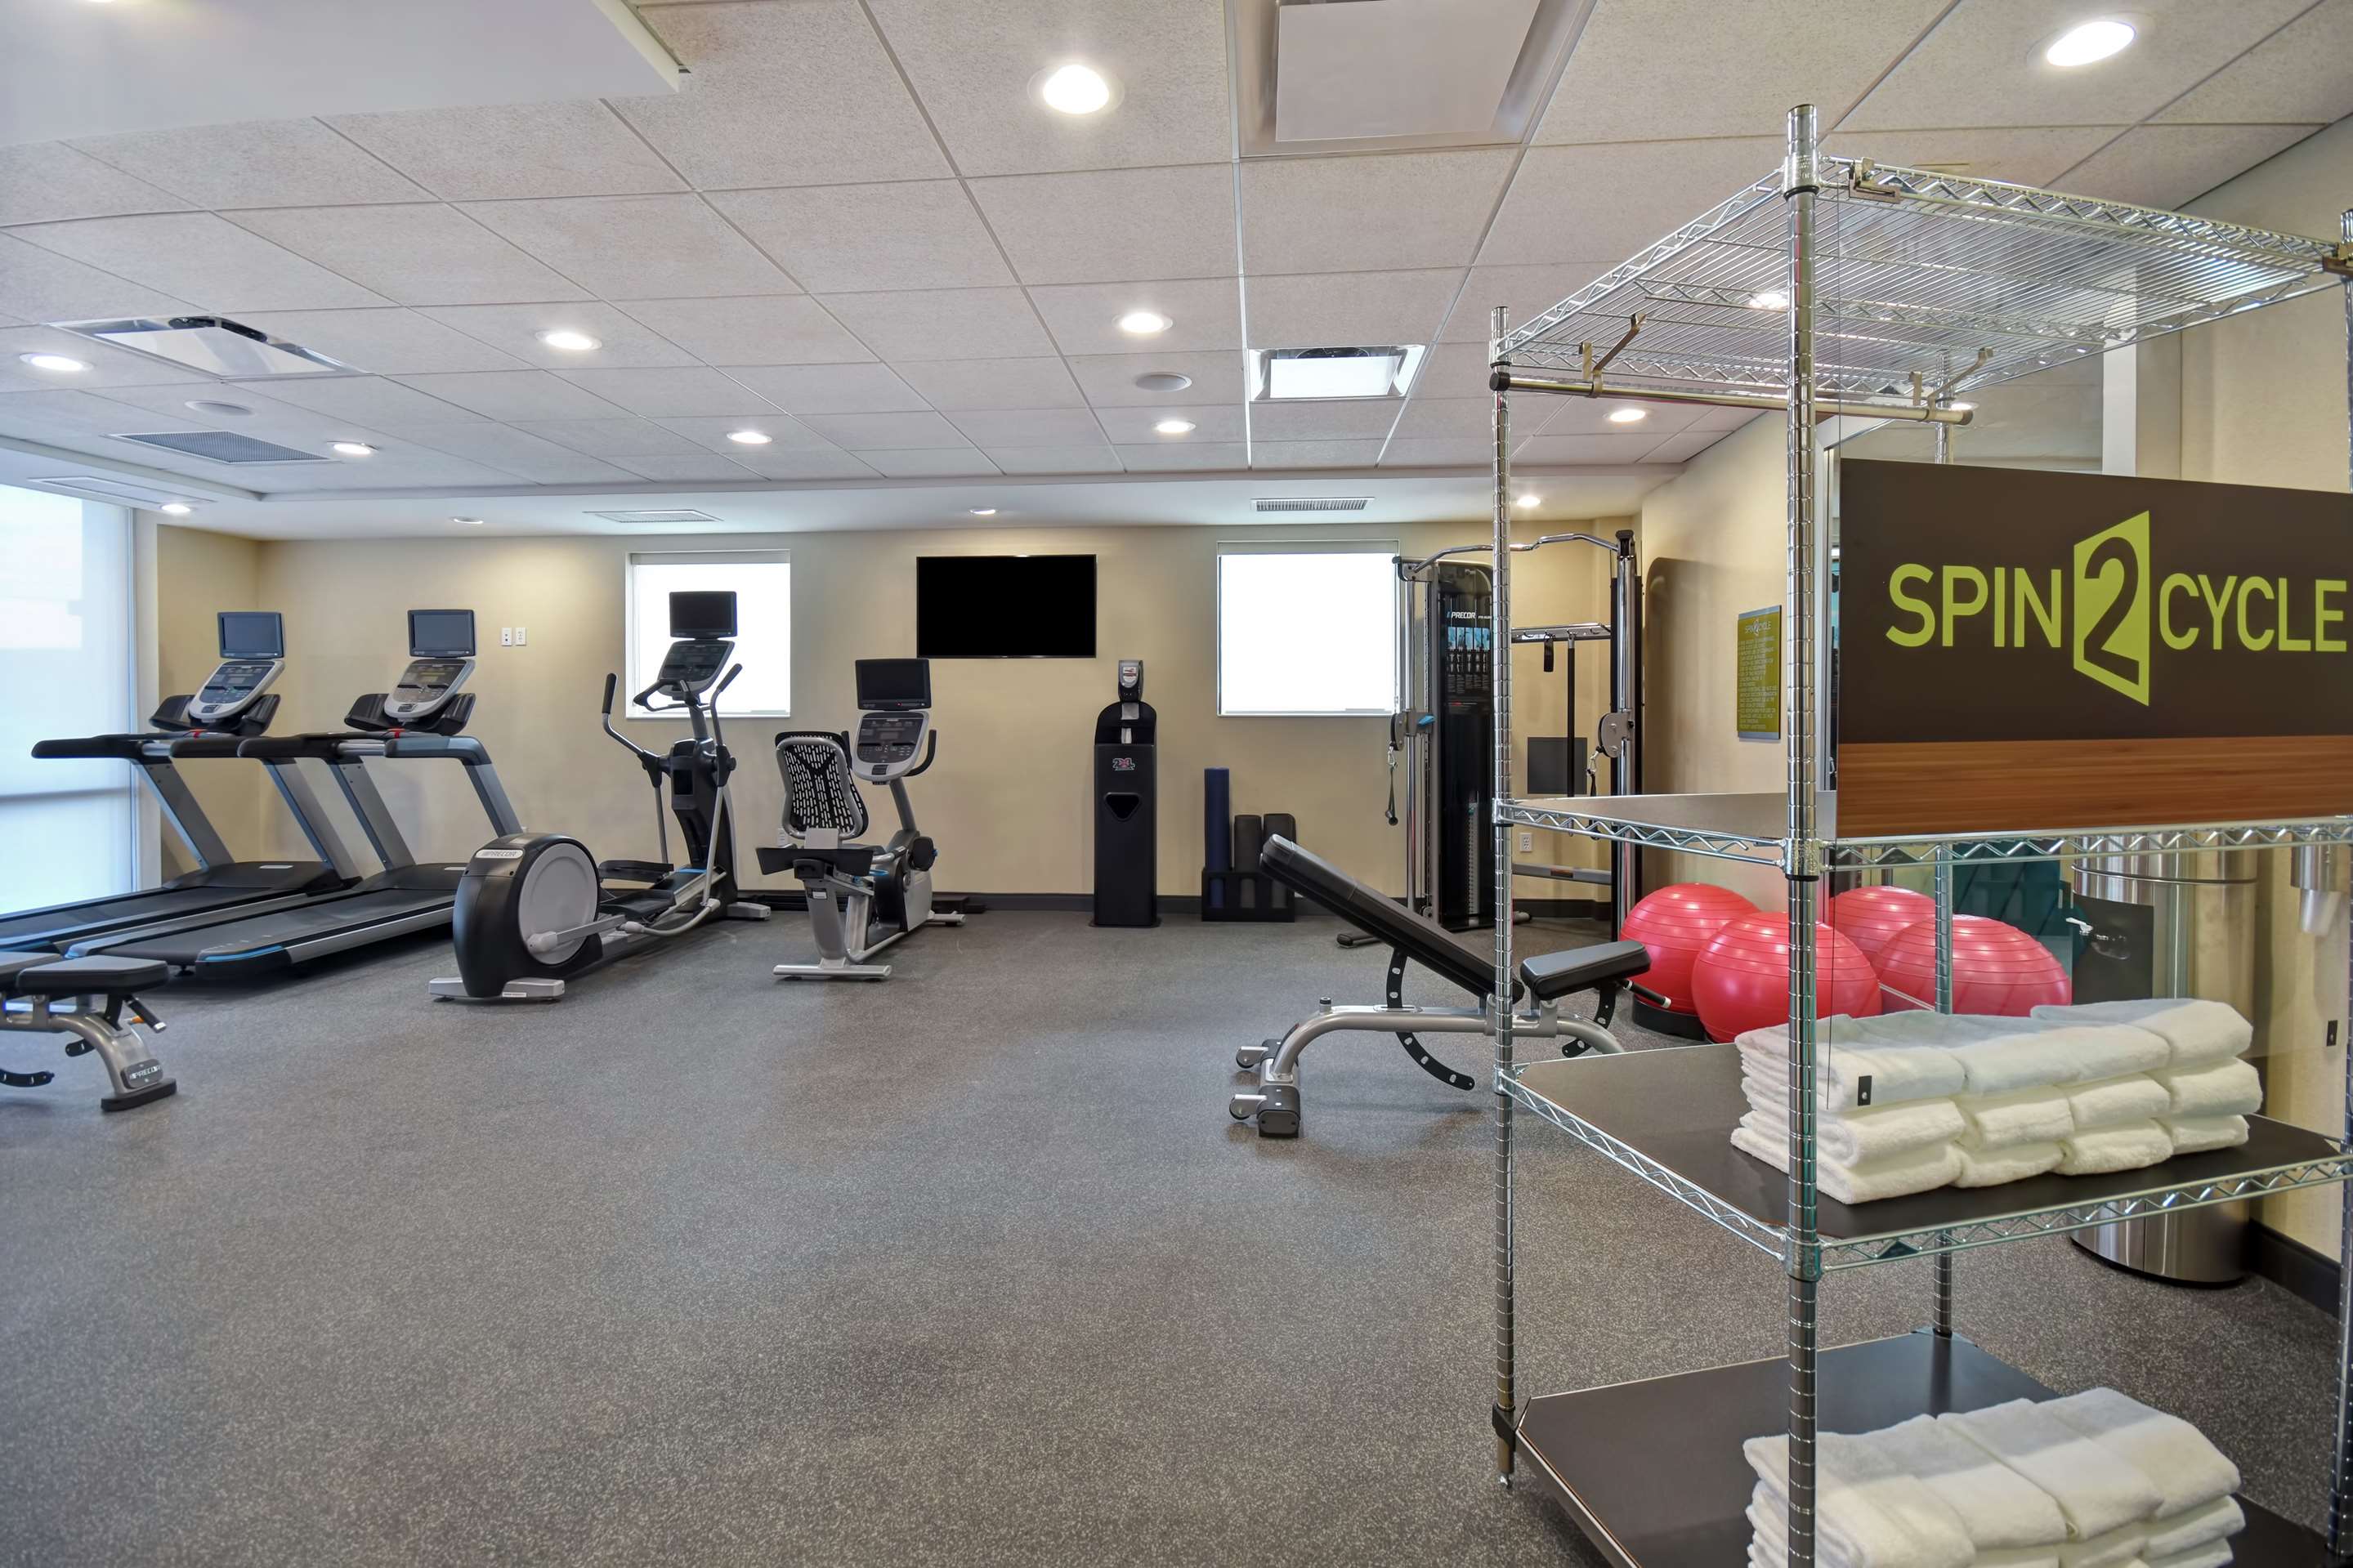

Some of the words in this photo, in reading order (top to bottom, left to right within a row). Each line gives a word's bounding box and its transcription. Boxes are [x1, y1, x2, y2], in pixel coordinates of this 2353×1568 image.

[1451, 611, 1476, 619] PRECOR
[1886, 563, 2062, 648] SPIN
[2159, 573, 2347, 652] CYCLE
